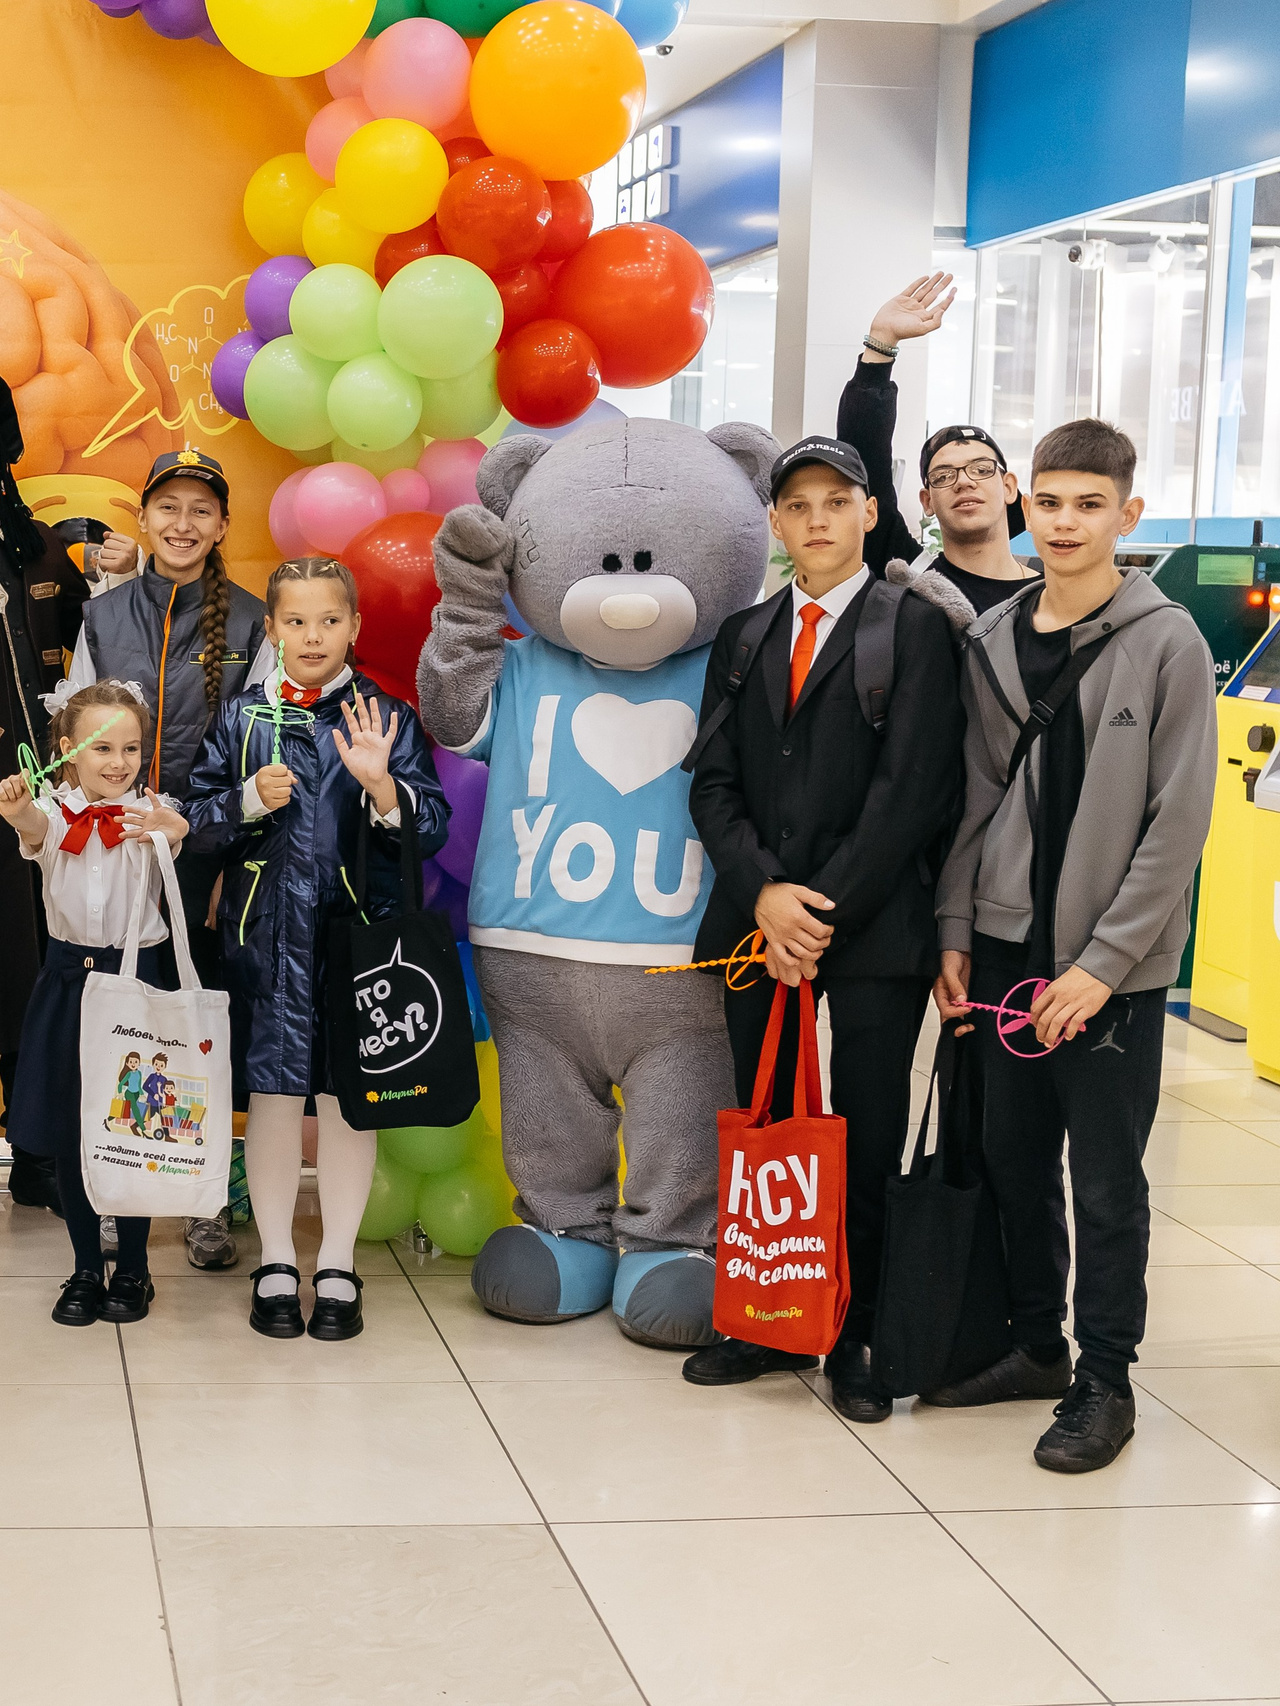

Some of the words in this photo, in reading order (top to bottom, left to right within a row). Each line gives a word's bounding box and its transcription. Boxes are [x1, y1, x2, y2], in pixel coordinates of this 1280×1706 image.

[1108, 719, 1138, 727] adidas
[527, 694, 562, 797] I
[512, 803, 705, 917] YOU
[112, 1024, 154, 1041] Любовь
[101, 1155, 142, 1169] магазин
[143, 1152, 166, 1161] всей
[168, 1156, 206, 1166] семьёй
[758, 1263, 827, 1286] семьи
